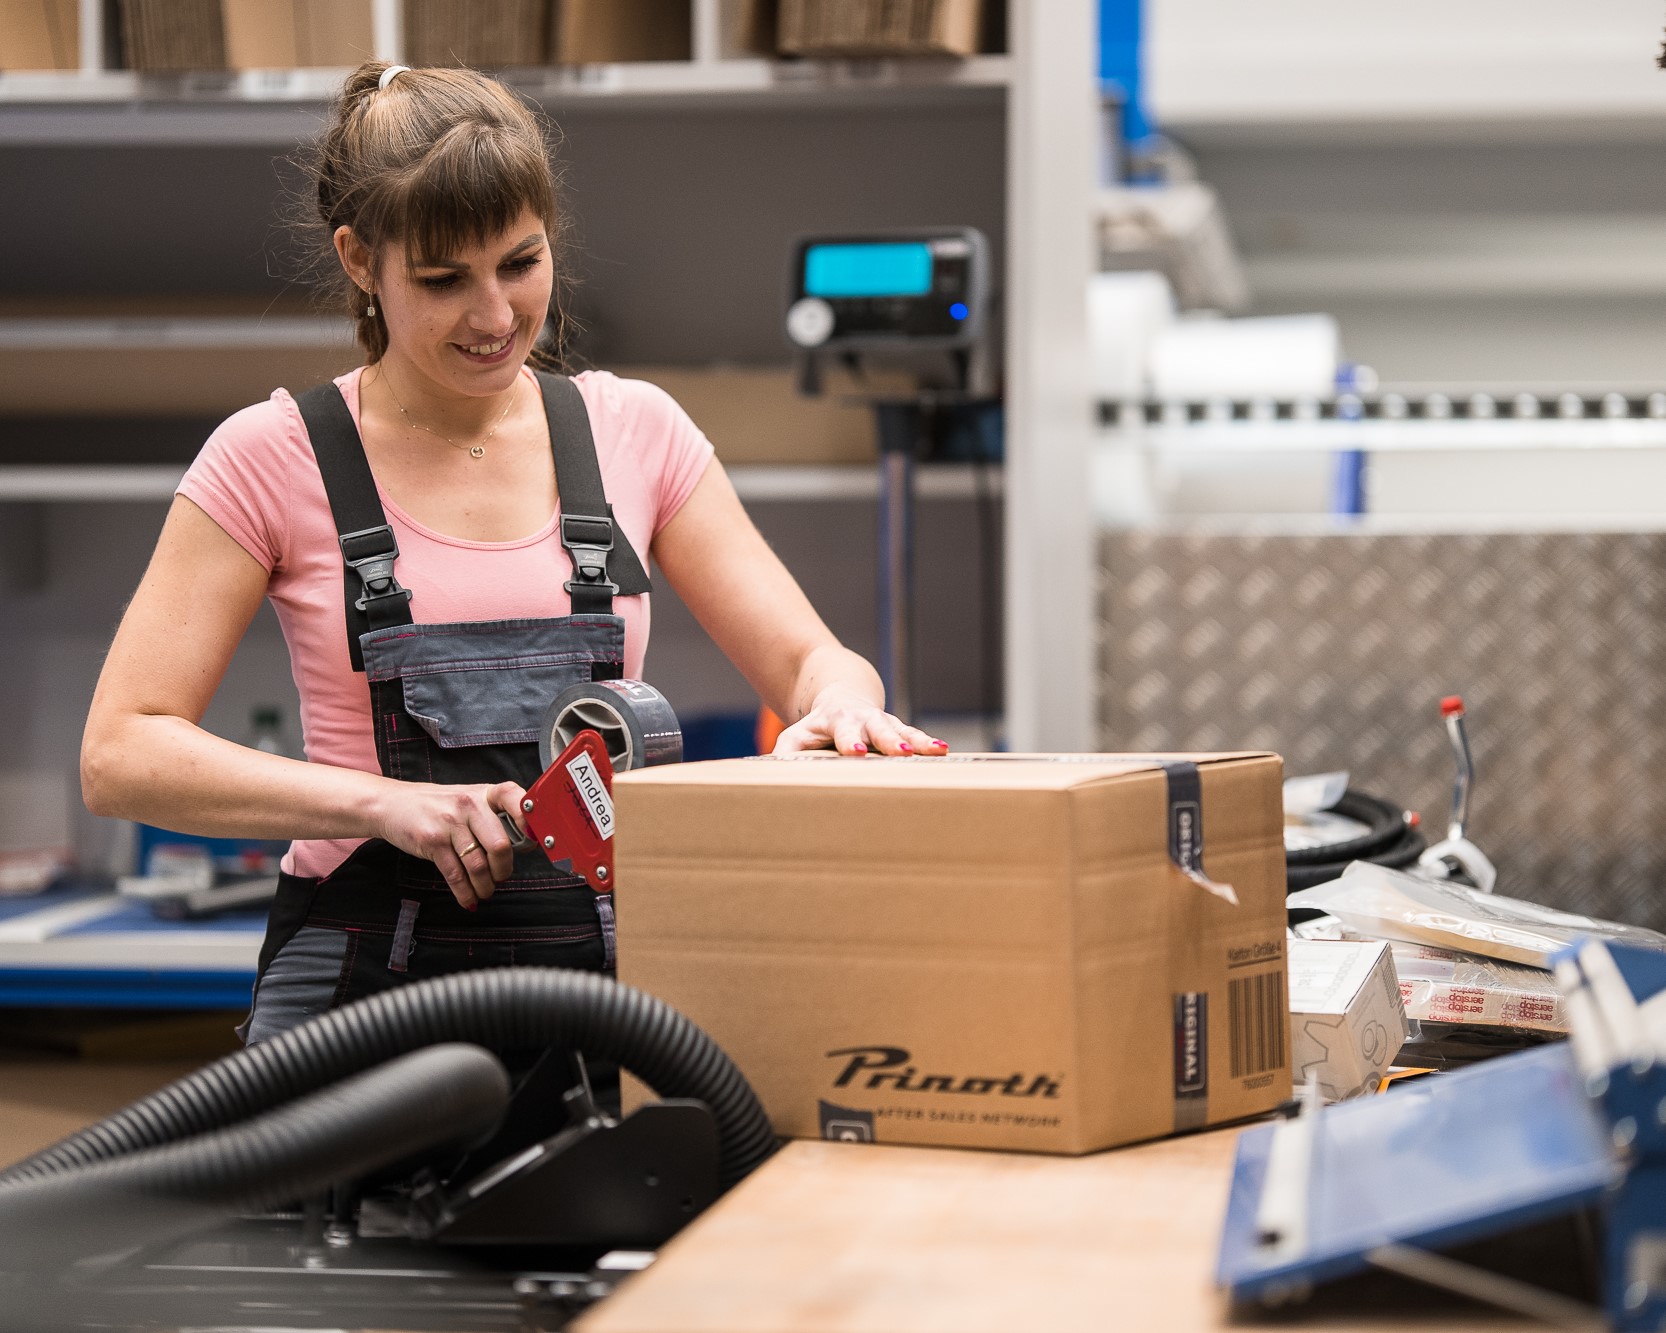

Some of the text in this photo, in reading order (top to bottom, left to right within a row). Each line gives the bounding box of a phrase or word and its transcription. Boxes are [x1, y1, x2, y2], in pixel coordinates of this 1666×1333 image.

[575, 765, 611, 827] Andrea
[1449, 993, 1484, 1005] aerstop
[1448, 1002, 1483, 1014] aerstop
[1520, 1000, 1553, 1012] aerstop
[1519, 1010, 1552, 1021] aerstop
[825, 1046, 1061, 1098] Prinoth
[877, 1106, 1061, 1128] AFTER SALES NETWORK
